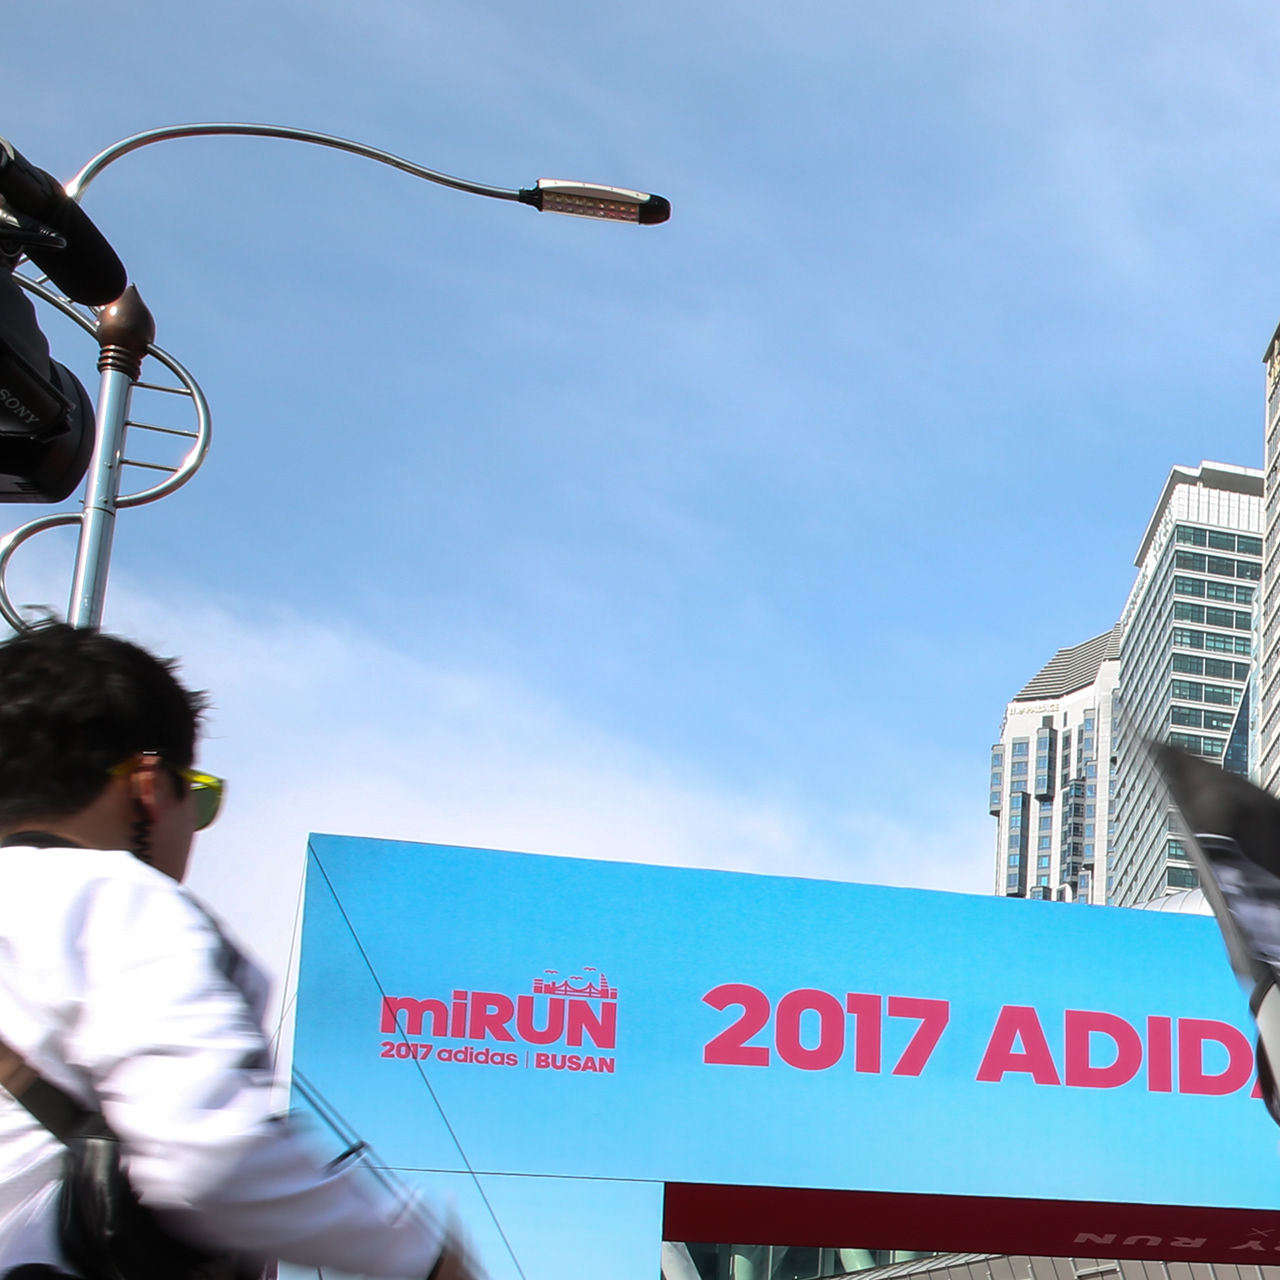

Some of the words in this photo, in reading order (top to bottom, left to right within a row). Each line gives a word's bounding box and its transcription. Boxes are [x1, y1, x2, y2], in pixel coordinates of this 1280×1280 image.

[0, 389, 40, 424] SONY
[380, 989, 617, 1050] miRUN
[701, 983, 949, 1077] 2017
[975, 1005, 1264, 1098] ADID
[379, 1041, 433, 1061] 2017
[436, 1047, 519, 1067] adidas
[534, 1052, 616, 1074] BUSAN
